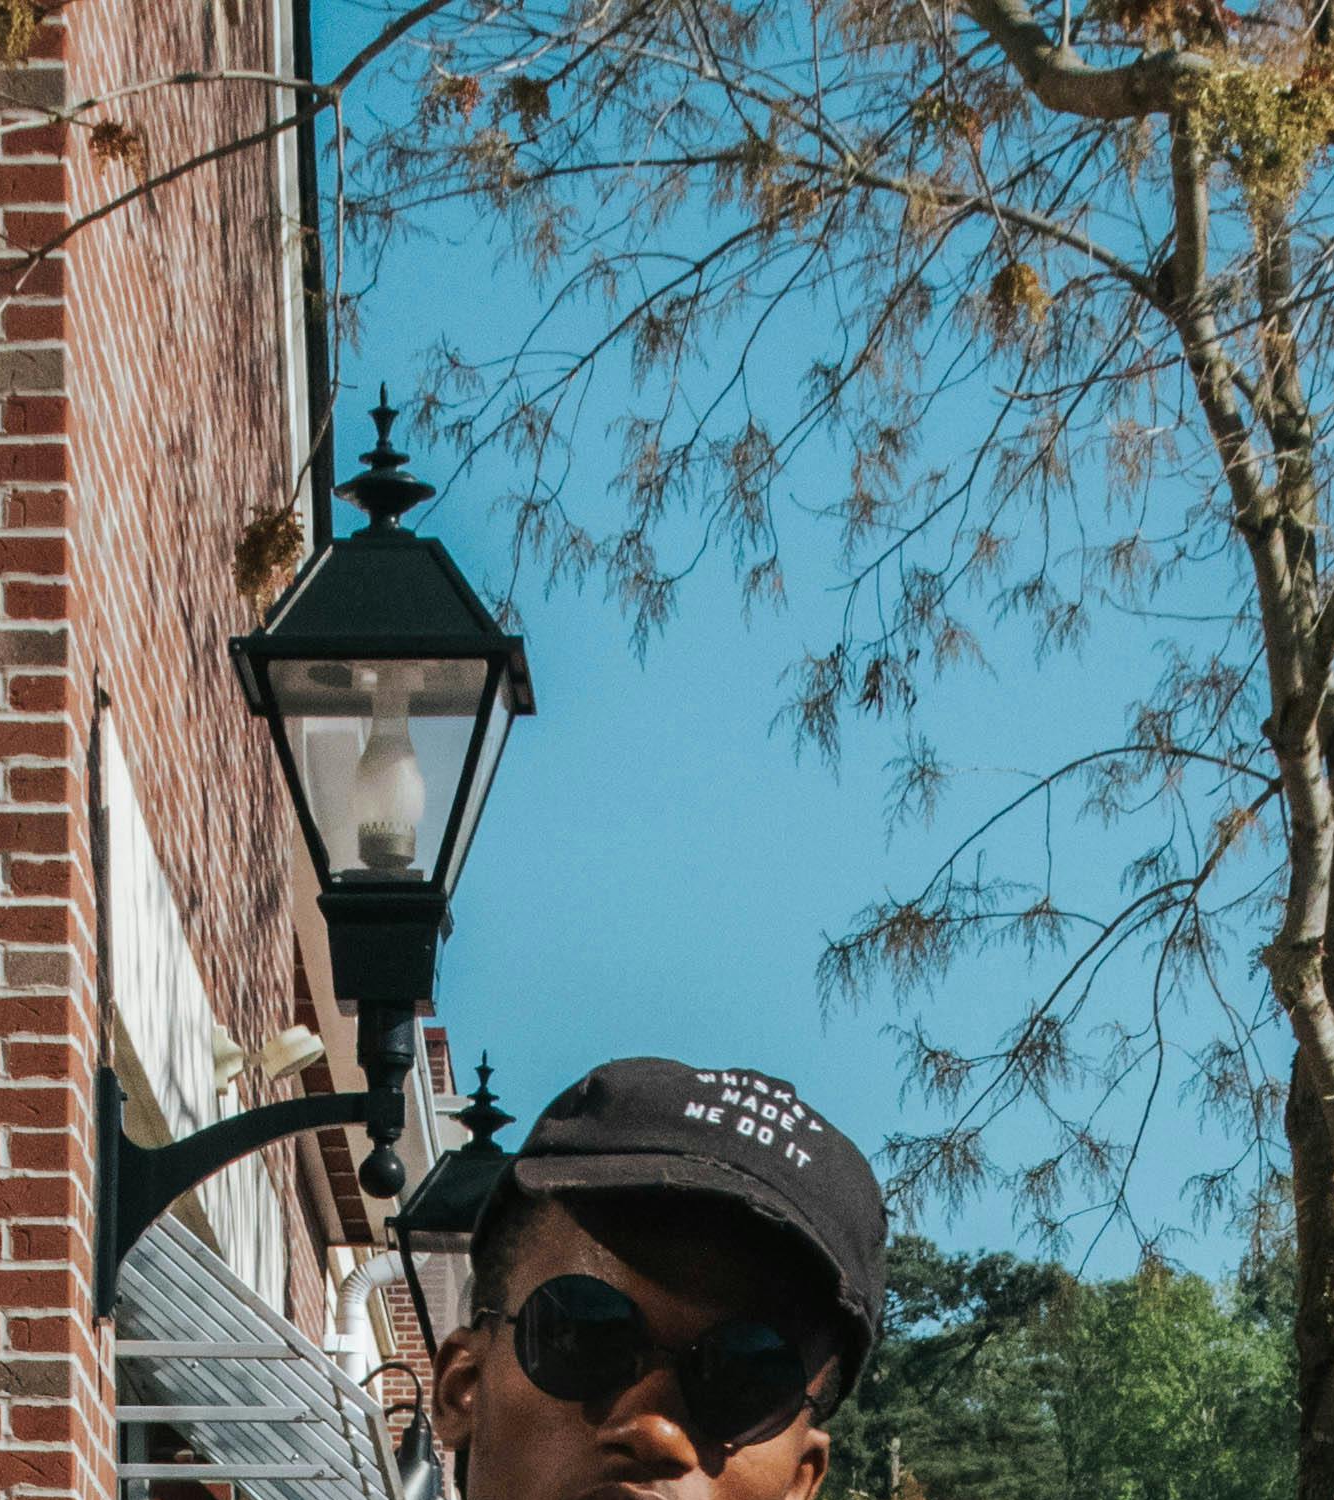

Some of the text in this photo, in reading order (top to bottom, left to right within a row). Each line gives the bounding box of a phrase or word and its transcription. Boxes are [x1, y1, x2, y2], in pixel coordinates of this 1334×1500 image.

[695, 1072, 823, 1132] WHISKEY
[721, 1088, 796, 1132] MADE
[684, 1101, 812, 1168] ME DO IT
